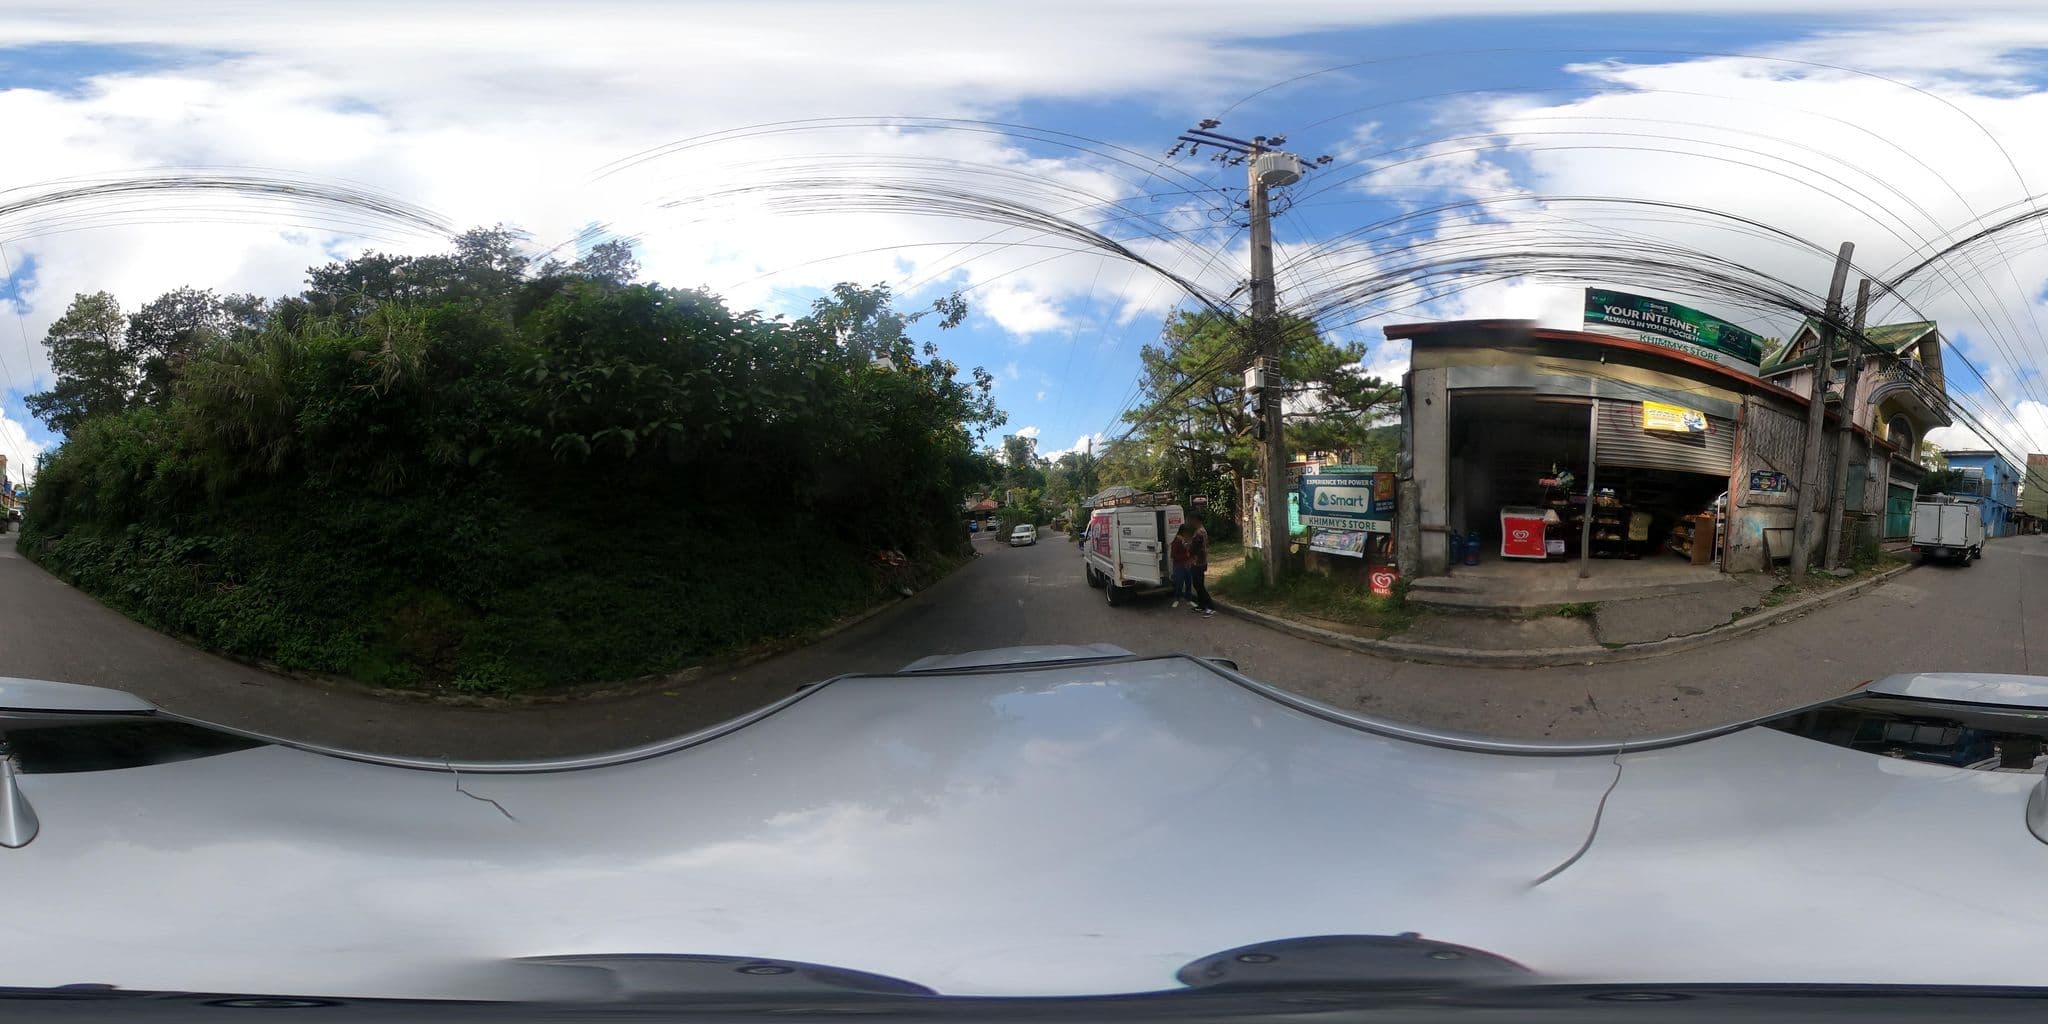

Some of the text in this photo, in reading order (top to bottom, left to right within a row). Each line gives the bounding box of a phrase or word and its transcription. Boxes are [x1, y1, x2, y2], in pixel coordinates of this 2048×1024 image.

[1603, 305, 1640, 320] YOUR
[1603, 315, 1636, 327] ALWAYS
[1636, 320, 1646, 328] IN
[1646, 322, 1668, 334] YOUR
[1690, 346, 1719, 362] STORE
[1330, 494, 1364, 507] Smart
[1309, 517, 1377, 530] KHIMMY'S STORE
